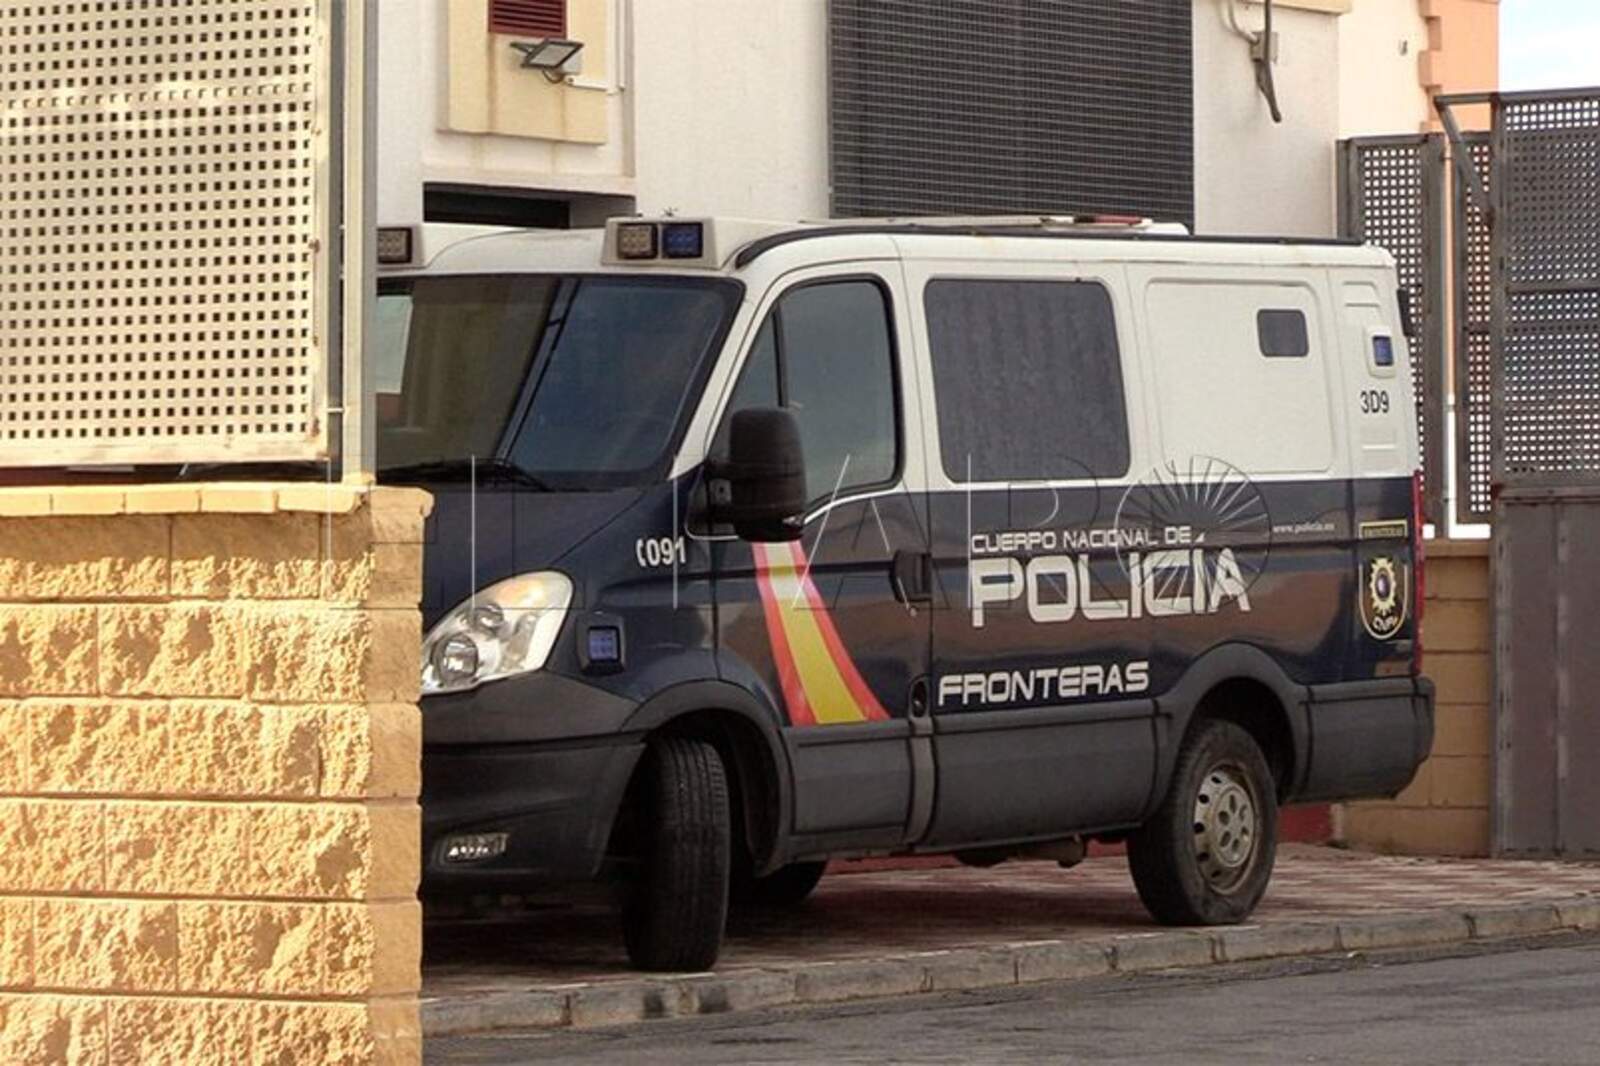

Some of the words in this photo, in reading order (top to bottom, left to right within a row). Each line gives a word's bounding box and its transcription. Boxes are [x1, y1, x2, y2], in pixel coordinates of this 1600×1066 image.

[1360, 390, 1389, 413] 3D9
[971, 534, 1057, 553] CUERPO
[1063, 528, 1158, 549] NACIONAL
[1164, 525, 1192, 544] DE
[938, 661, 1149, 706] FRONTERAS
